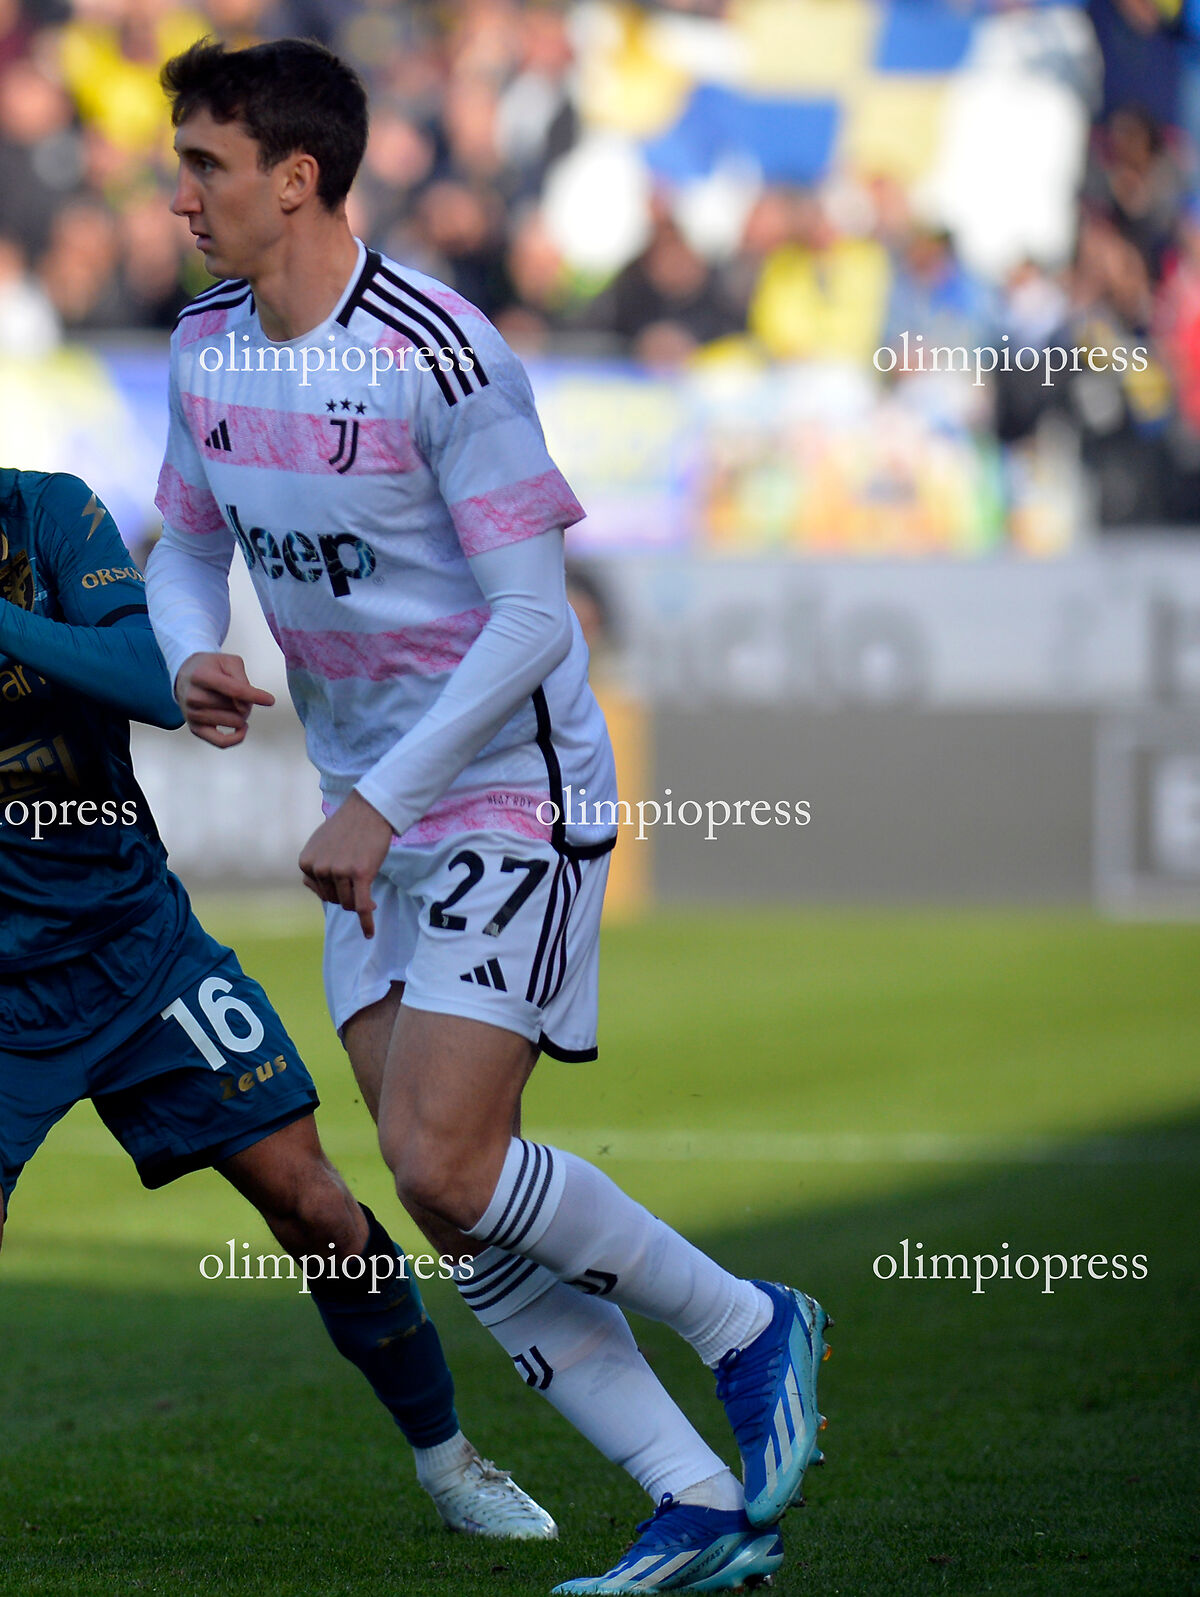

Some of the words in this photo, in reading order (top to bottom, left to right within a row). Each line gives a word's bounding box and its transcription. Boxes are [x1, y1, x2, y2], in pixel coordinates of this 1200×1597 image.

[225, 503, 377, 598] Jeep
[429, 849, 550, 938] 27
[160, 976, 265, 1072] 16
